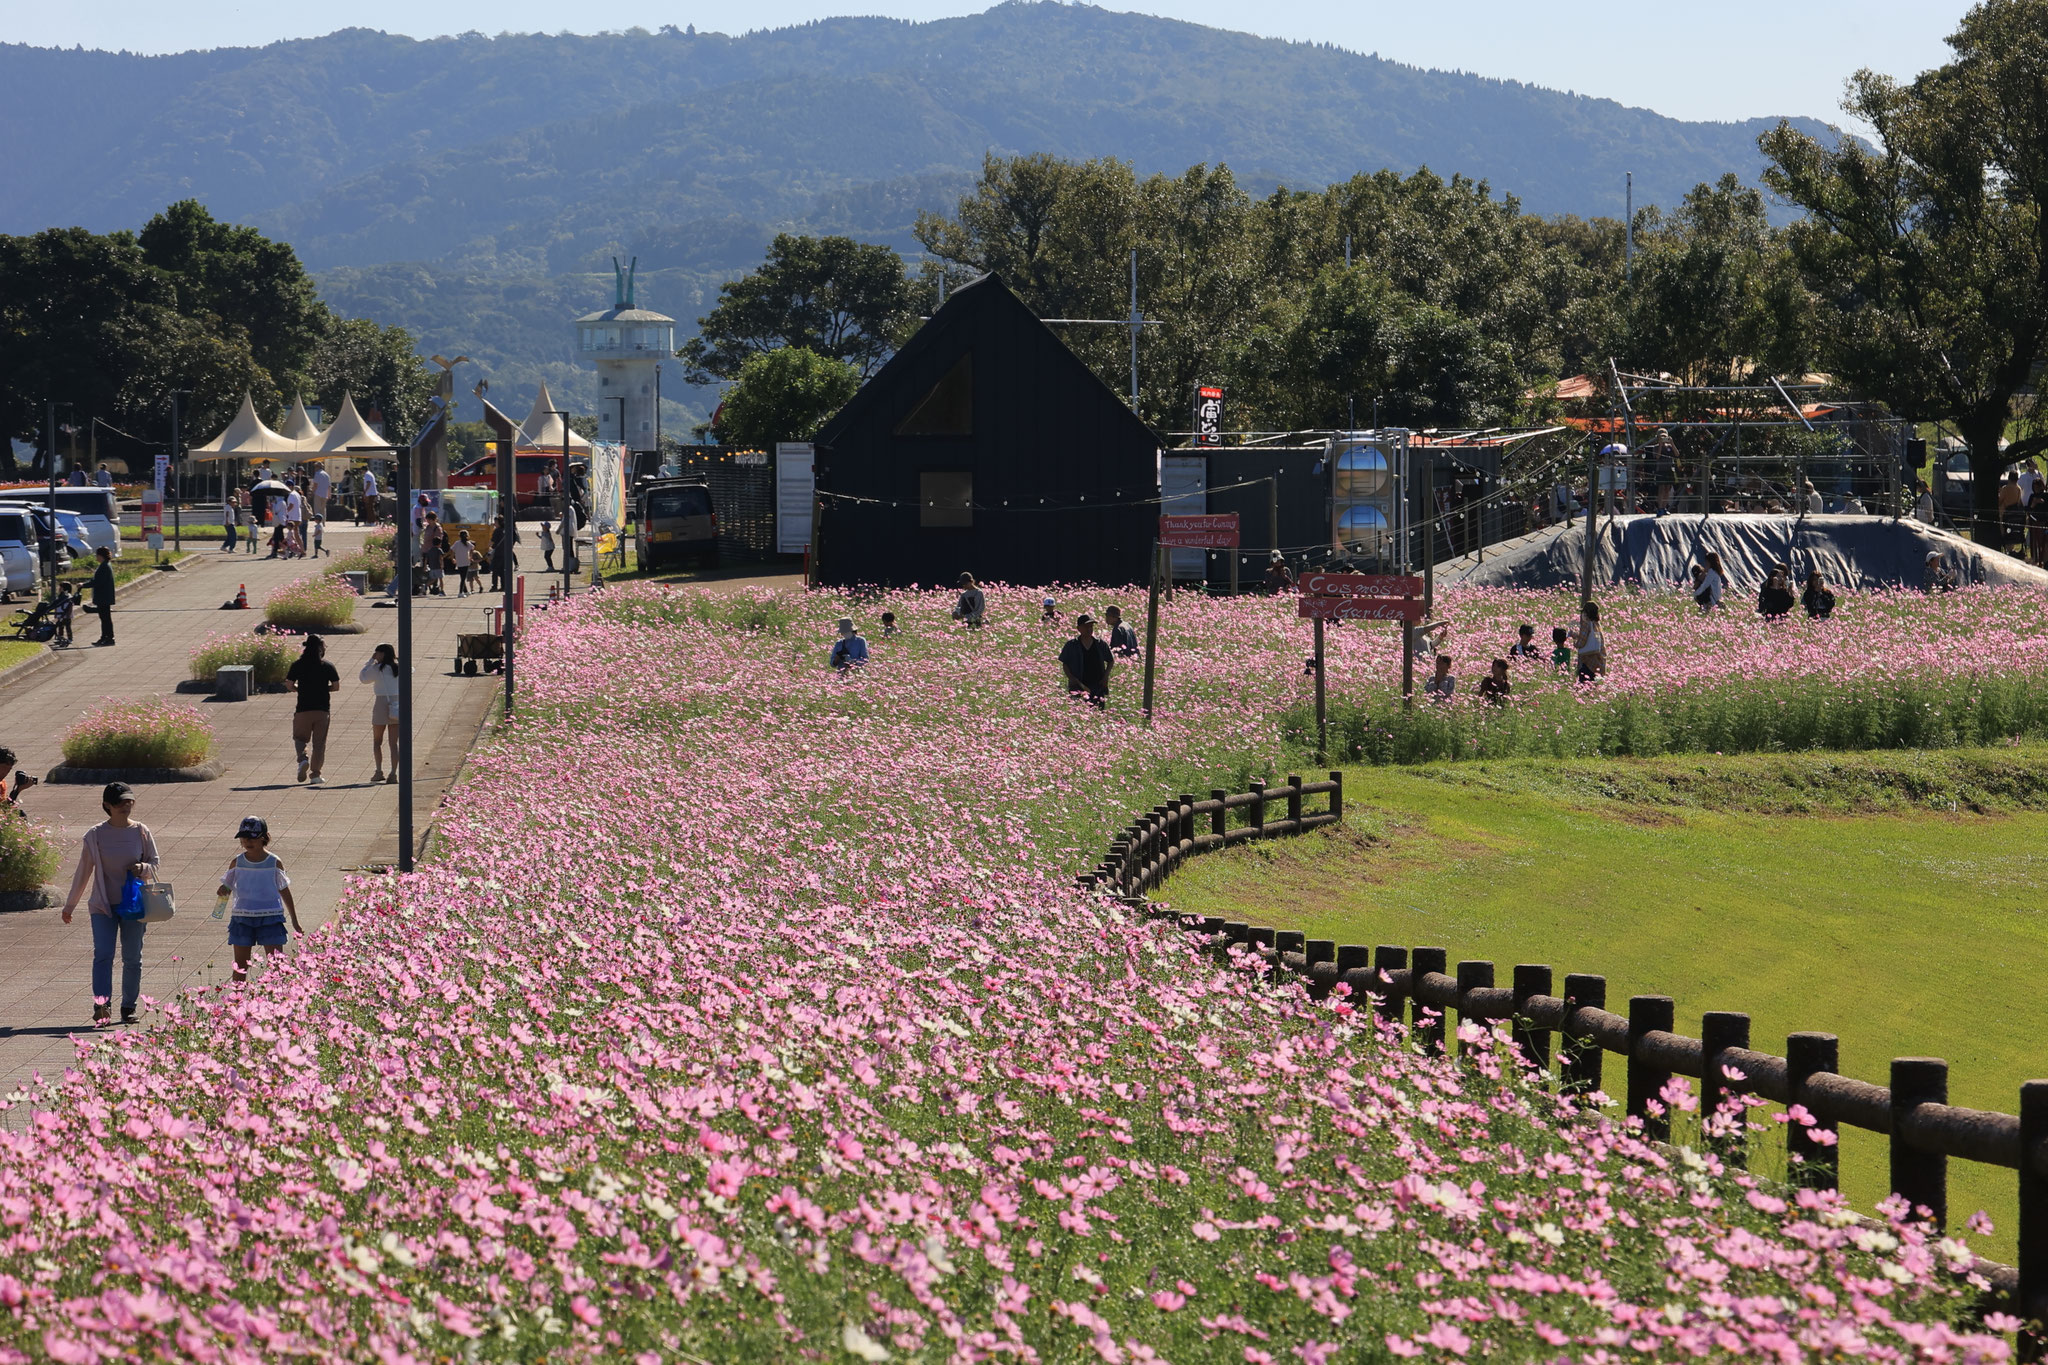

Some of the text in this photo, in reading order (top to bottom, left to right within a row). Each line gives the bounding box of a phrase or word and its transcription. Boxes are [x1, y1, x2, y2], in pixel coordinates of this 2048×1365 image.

[1165, 519, 1189, 529] Thank
[1216, 534, 1232, 546] day
[1309, 576, 1392, 595] Cosmos
[1333, 600, 1405, 620] Garden
